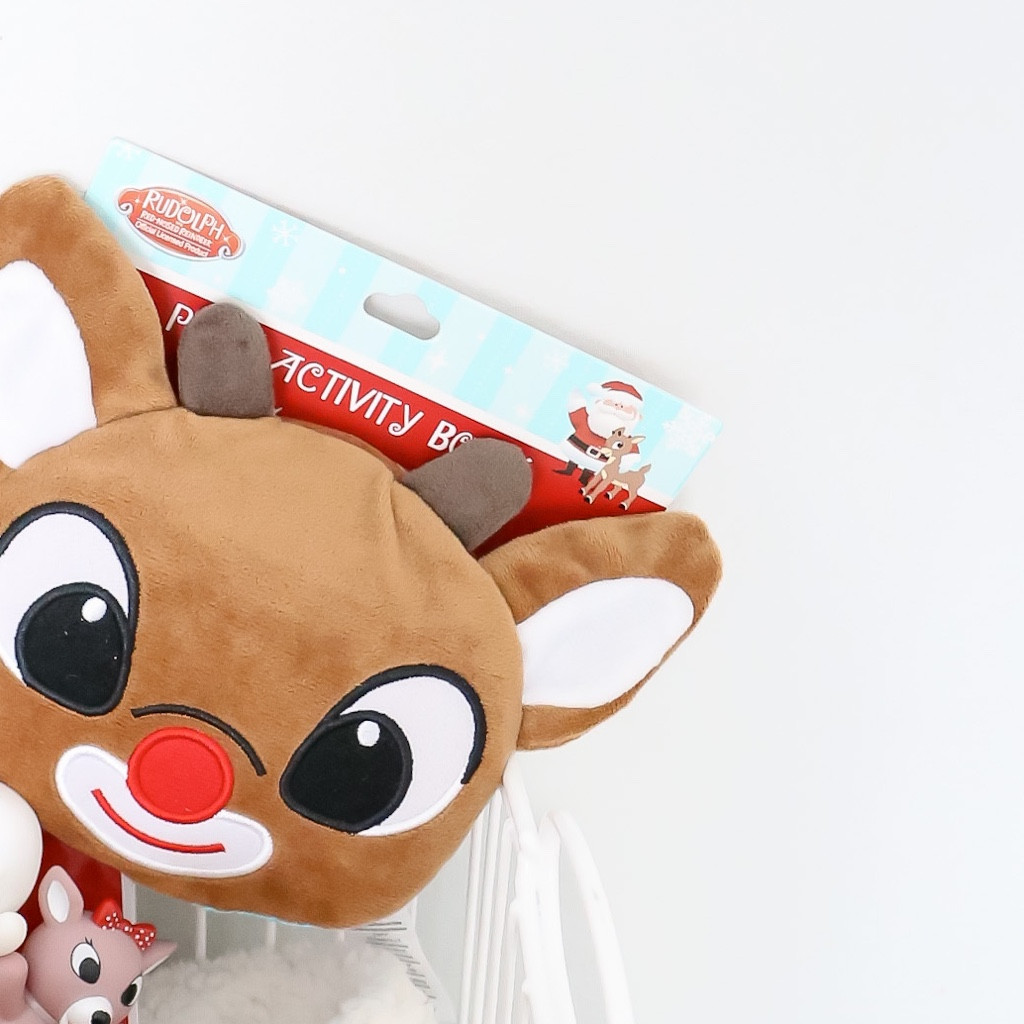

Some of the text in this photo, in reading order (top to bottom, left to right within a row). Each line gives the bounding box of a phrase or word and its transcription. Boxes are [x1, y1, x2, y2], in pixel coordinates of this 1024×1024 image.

[142, 189, 224, 240] RUDOLPH
[157, 229, 184, 247] Licensed
[184, 241, 209, 258] Product
[271, 349, 424, 437] ACTIVITY
